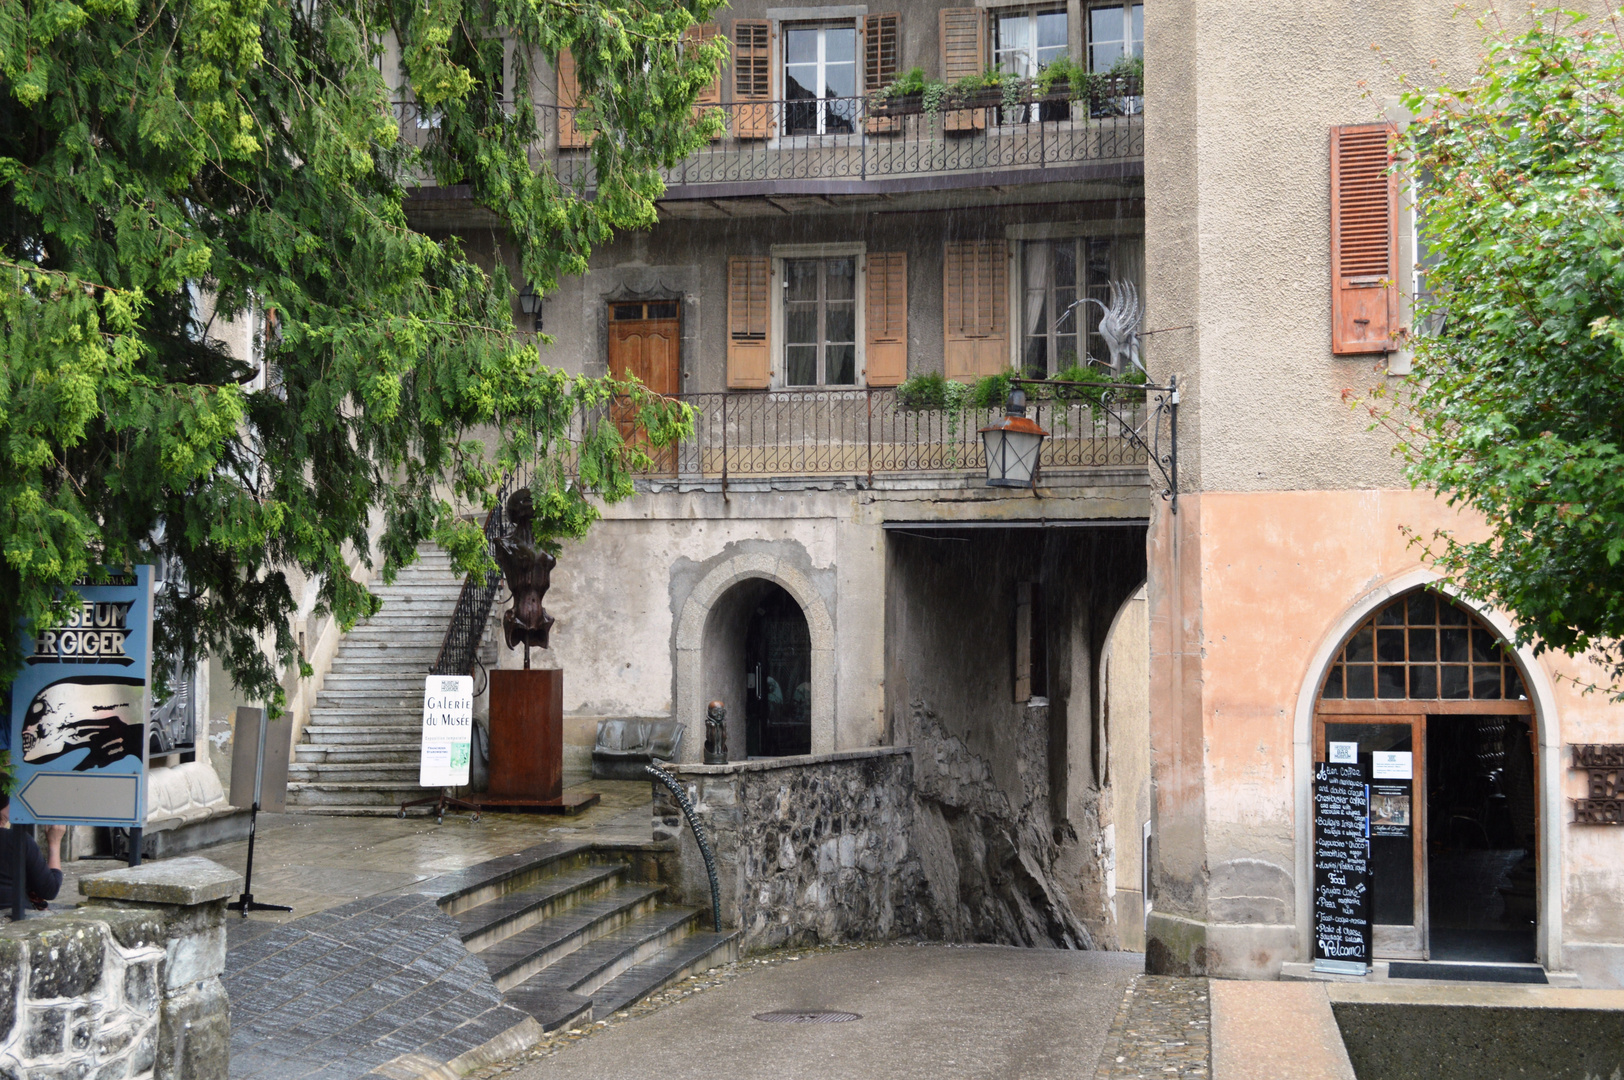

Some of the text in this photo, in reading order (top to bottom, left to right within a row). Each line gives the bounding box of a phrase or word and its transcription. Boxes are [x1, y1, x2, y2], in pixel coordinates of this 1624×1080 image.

[60, 631, 125, 655] GIGER
[426, 713, 437, 726] du
[1572, 745, 1624, 766] MUS
[1328, 872, 1346, 885] Food
